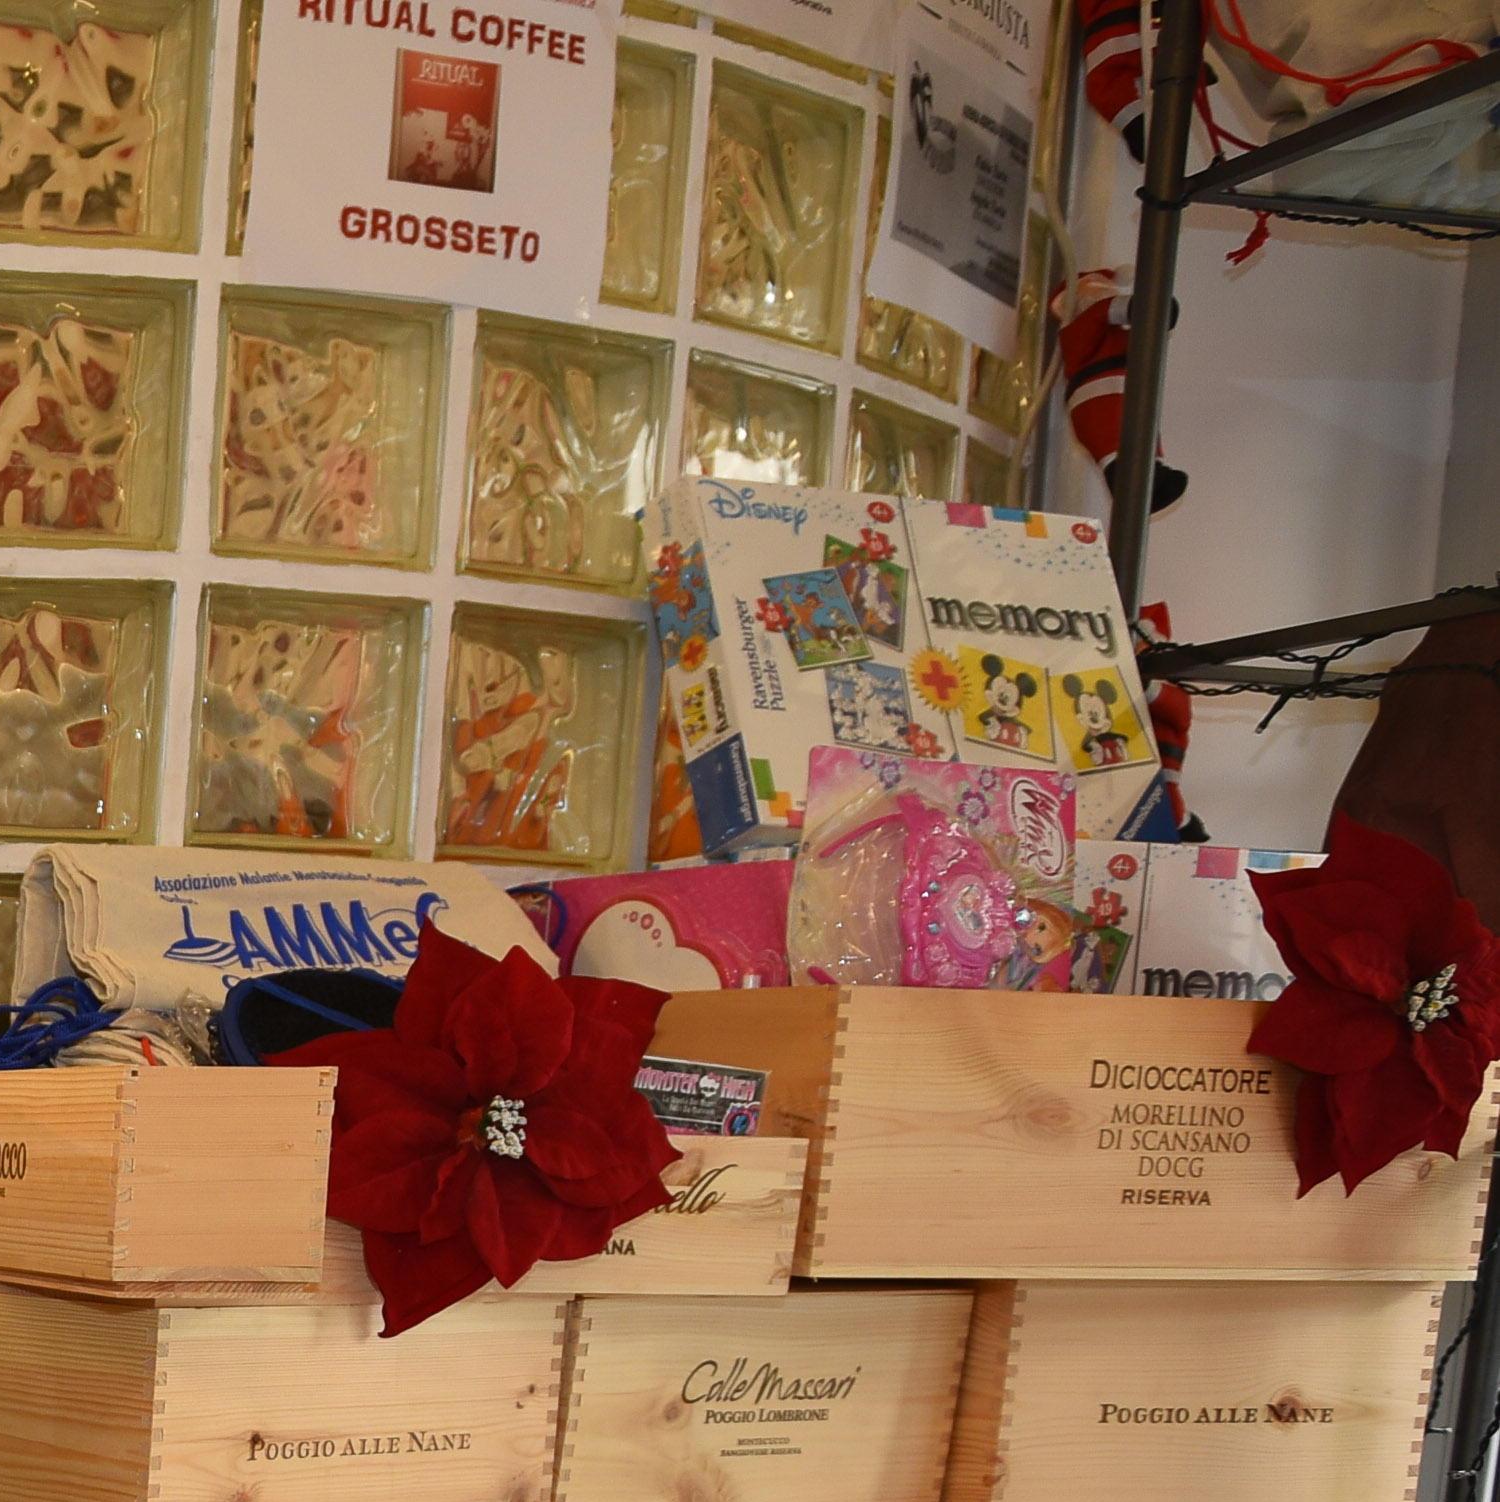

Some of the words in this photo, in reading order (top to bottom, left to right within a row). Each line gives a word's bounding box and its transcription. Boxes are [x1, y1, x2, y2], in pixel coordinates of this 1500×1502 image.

[451, 8, 586, 65] COFFEE
[419, 59, 483, 87] RITUAL
[338, 205, 540, 263] GROSSETO
[927, 595, 1118, 659] memory
[734, 593, 770, 711] Ravensburger
[765, 659, 787, 712] Puzzle
[154, 873, 237, 893] Associazione
[1110, 1103, 1244, 1128] MORELLINO
[1098, 1129, 1122, 1150] DI
[1131, 1130, 1250, 1153] SCANSANO
[1138, 1156, 1204, 1178] DOCG
[1121, 1188, 1212, 1206] RISERVA
[704, 1409, 756, 1424] POGGIO
[758, 1408, 829, 1423] LOMBRONE
[1098, 1403, 1190, 1424] POGGIO
[1192, 1408, 1258, 1424] ALLE
[1264, 1403, 1335, 1424] NANE
[247, 1436, 335, 1461] POGGIO
[340, 1437, 401, 1456] ALLE
[407, 1430, 472, 1452] NANE
